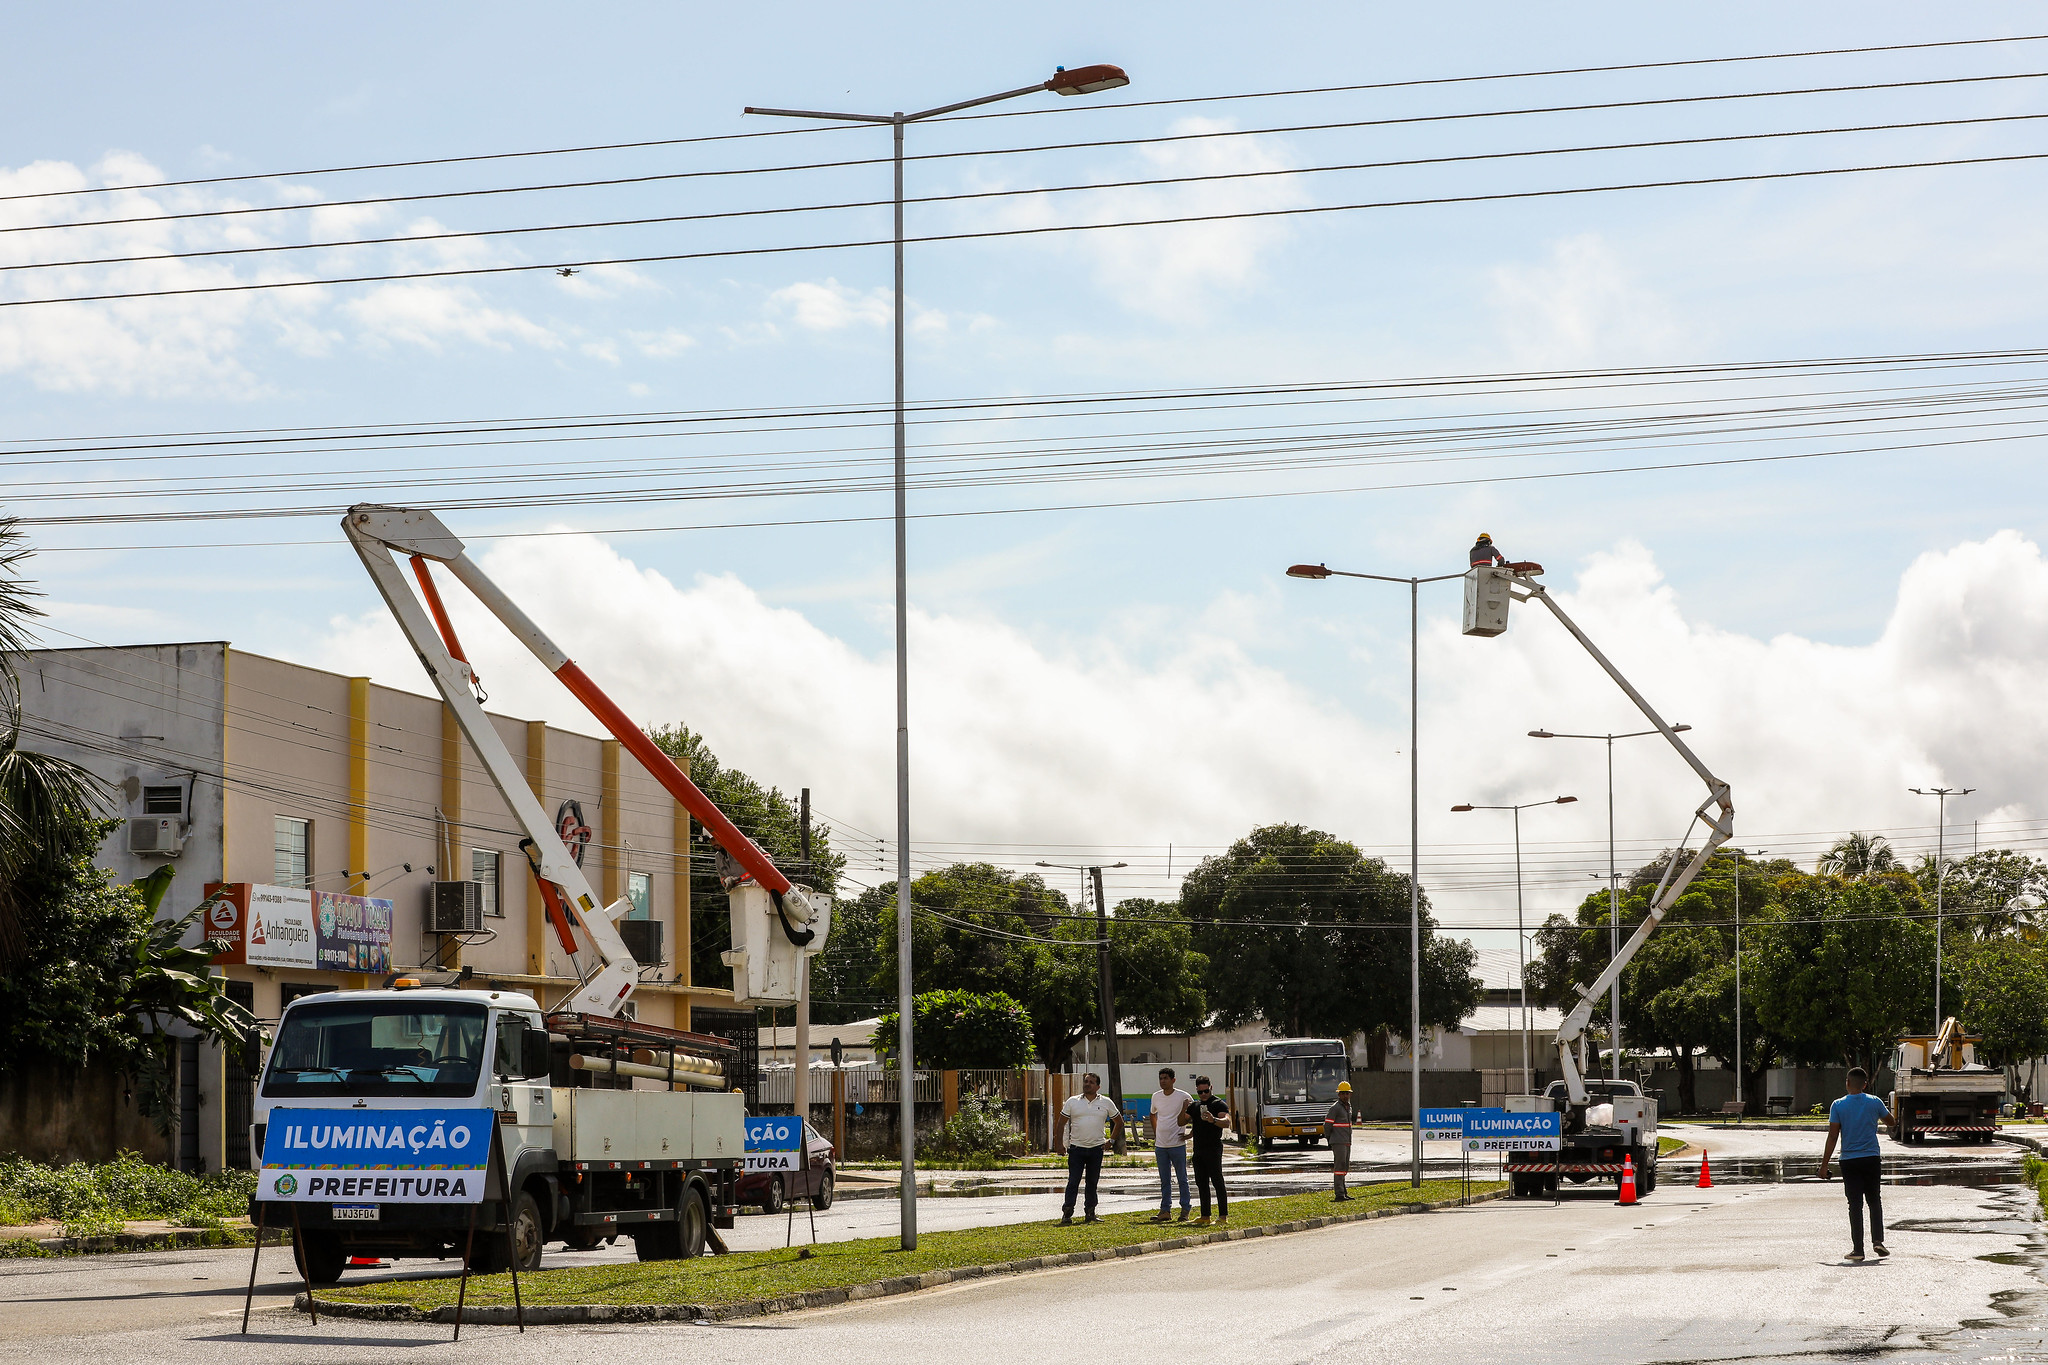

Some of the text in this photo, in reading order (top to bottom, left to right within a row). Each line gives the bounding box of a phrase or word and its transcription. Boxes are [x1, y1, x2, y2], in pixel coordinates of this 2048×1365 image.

[266, 920, 309, 947] Anhanguera
[1471, 1117, 1552, 1132] ILUMINAÇÃO
[284, 1120, 471, 1155] ILUMINAÇÃO
[1484, 1141, 1553, 1150] PREFEITURA
[308, 1178, 467, 1197] PREFEITURA
